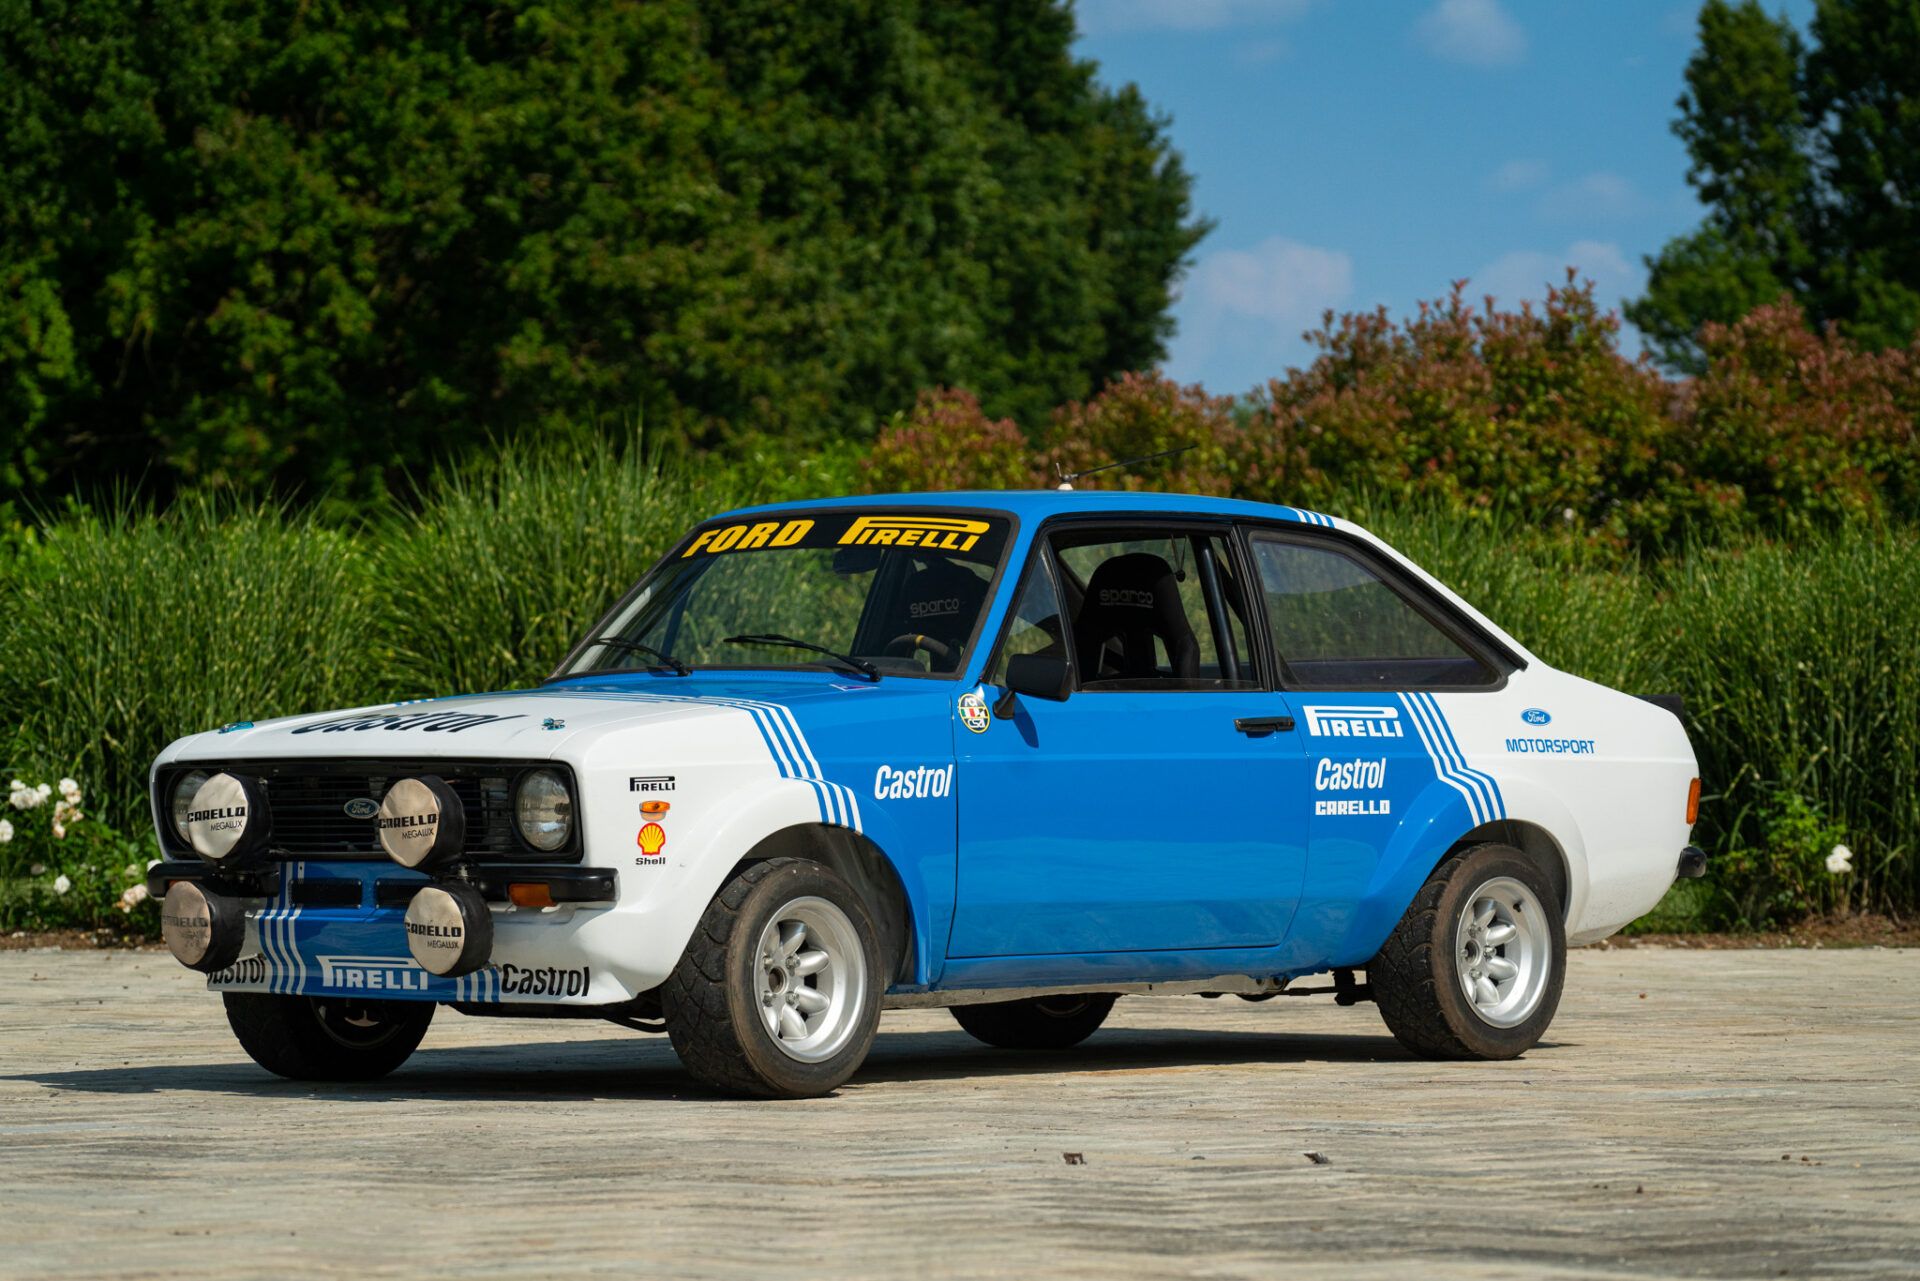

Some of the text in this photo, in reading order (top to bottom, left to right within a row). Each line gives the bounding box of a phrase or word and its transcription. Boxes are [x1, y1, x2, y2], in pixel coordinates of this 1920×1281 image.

[681, 516, 991, 558] FORD PIRELLI
[1100, 589, 1154, 606] sparco
[910, 598, 960, 617] sparco
[290, 711, 529, 735] Castrol
[1303, 705, 1404, 738] PIRELLI
[1505, 738, 1596, 754] MOTORSPORT
[873, 763, 954, 800] Castrol
[1315, 757, 1387, 791] Castrol
[629, 775, 676, 792] PIRELLI
[187, 806, 246, 823] CARELLO
[1315, 800, 1391, 816] CARELLO
[210, 820, 243, 832] MEGALUX
[378, 813, 438, 829] CARELLO
[401, 828, 435, 840] MEGALUX
[635, 857, 667, 866] Shell
[405, 922, 462, 938] CARELLO
[426, 940, 460, 950] MEGALUX
[207, 958, 266, 985] astrol
[315, 954, 429, 991] PIRELLI
[501, 963, 591, 997] Castrol
